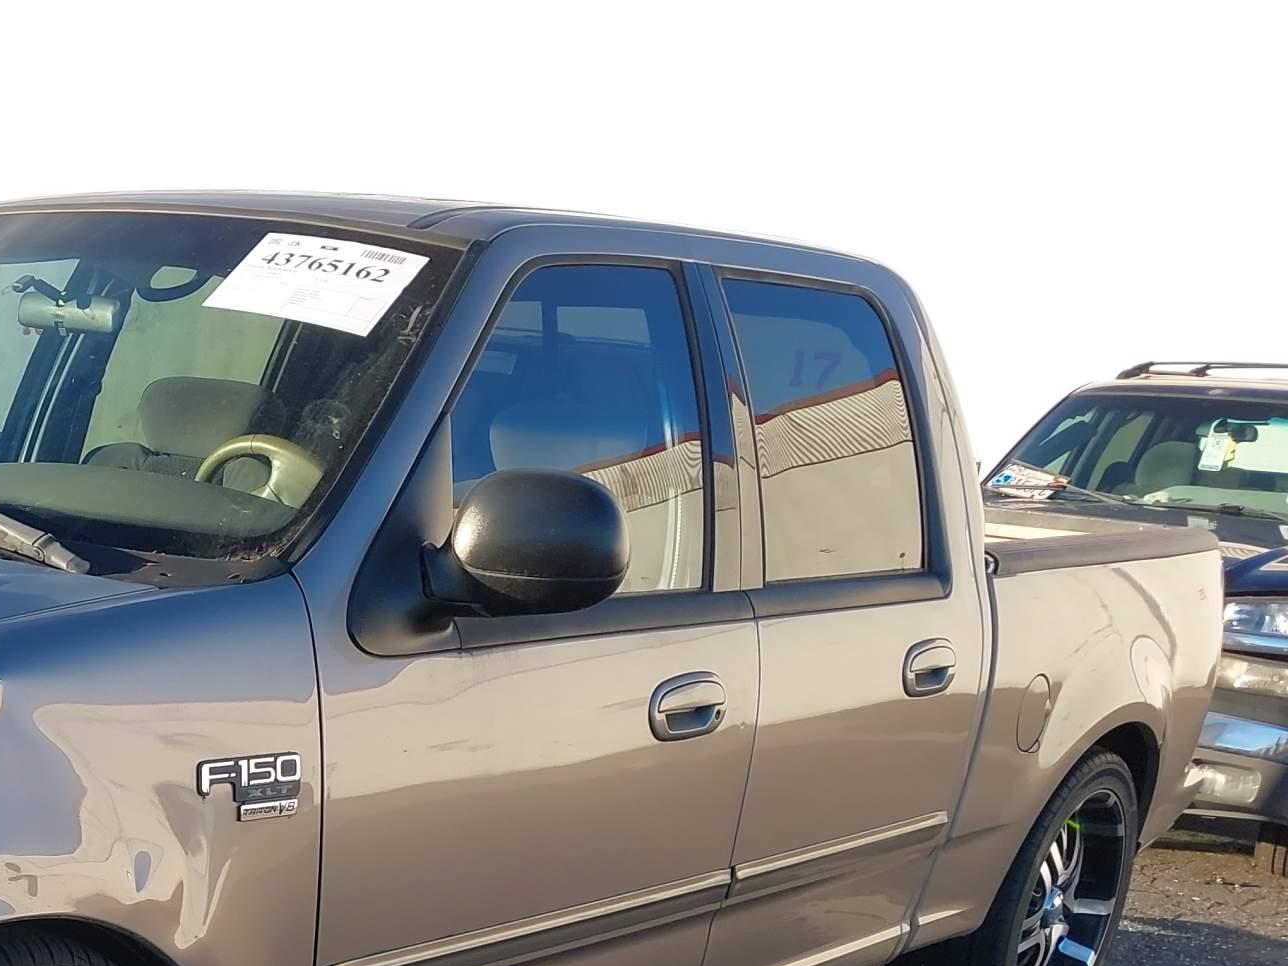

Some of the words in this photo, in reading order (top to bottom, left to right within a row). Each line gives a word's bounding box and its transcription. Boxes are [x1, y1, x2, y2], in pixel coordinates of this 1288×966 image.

[261, 251, 391, 283] 43765162
[201, 754, 301, 794] F-150
[247, 785, 292, 798] XLT
